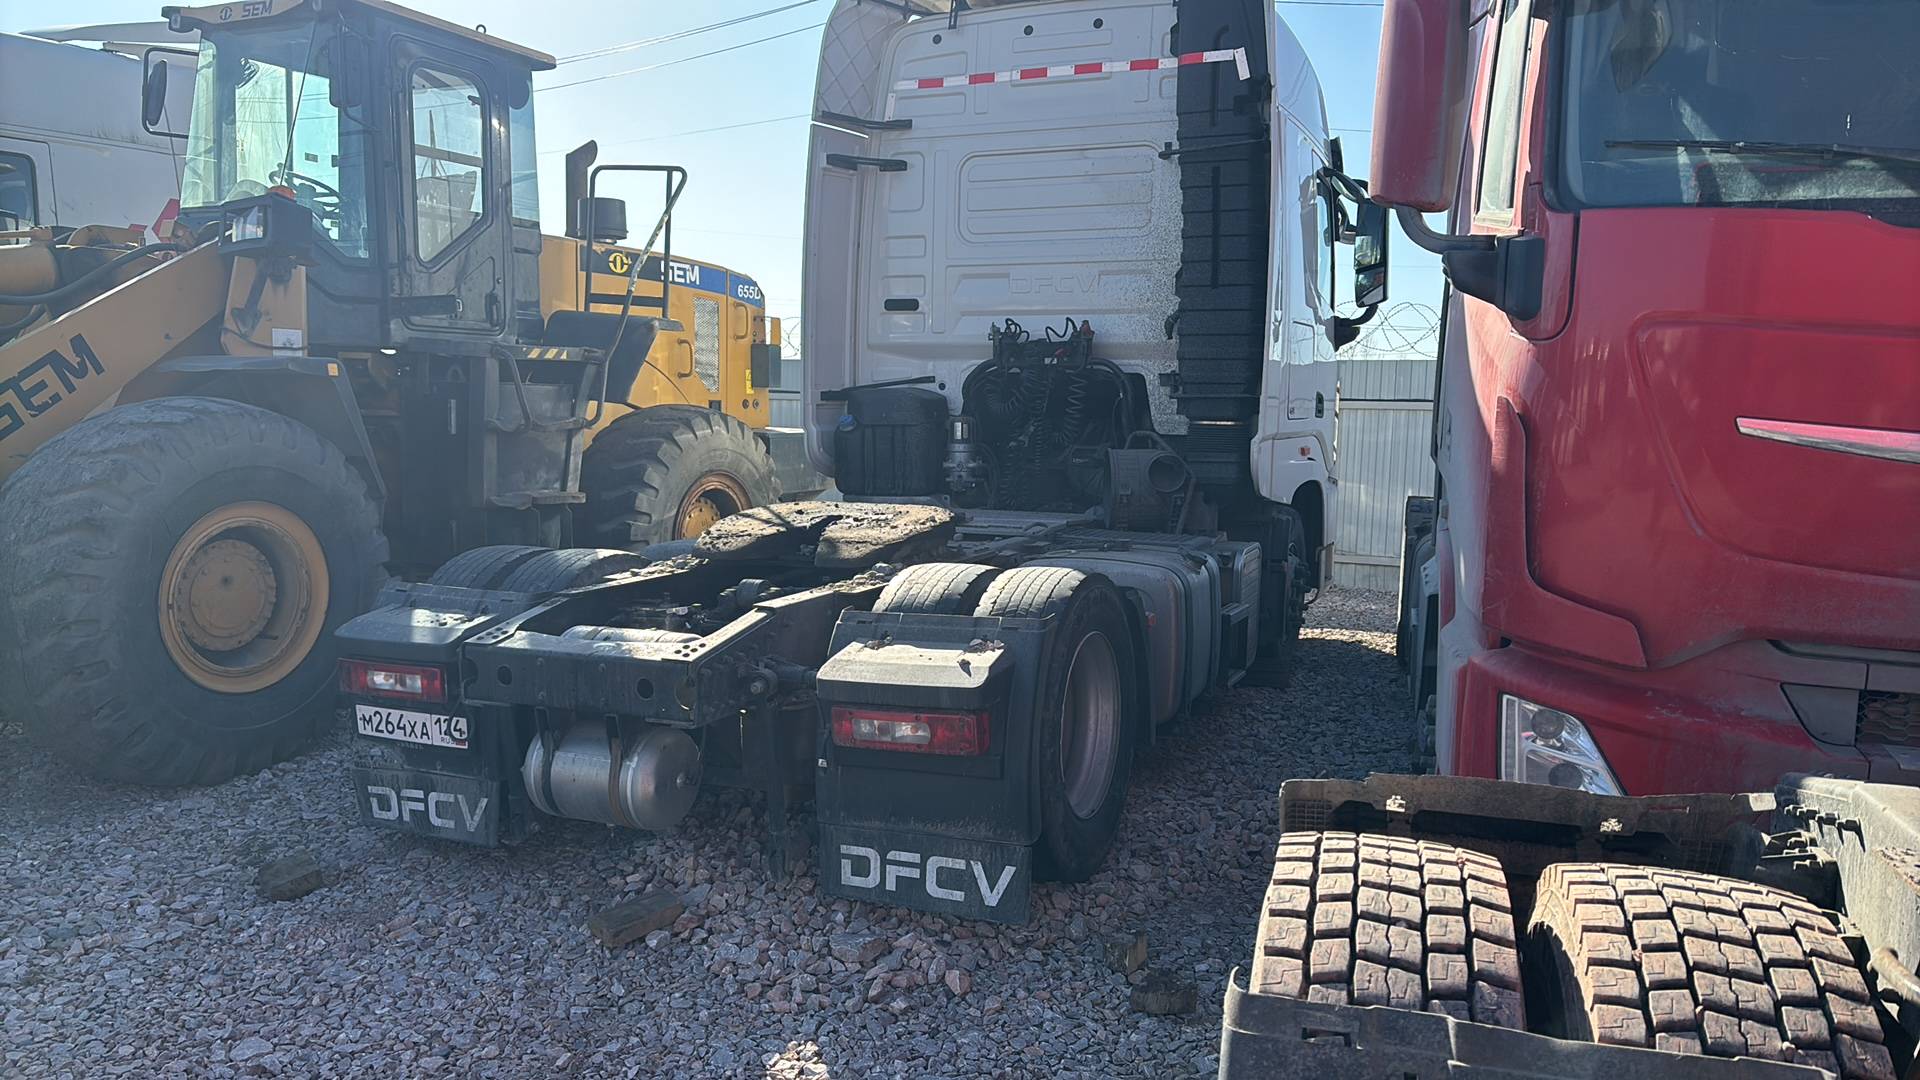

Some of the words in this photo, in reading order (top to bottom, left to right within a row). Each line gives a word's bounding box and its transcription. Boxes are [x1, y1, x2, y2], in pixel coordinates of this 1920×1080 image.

[242, 0, 273, 17] SEM
[737, 285, 762, 299] 655D
[1007, 271, 1099, 293] DFCV
[367, 785, 489, 832] DFCV
[840, 844, 1017, 907] DFCV
